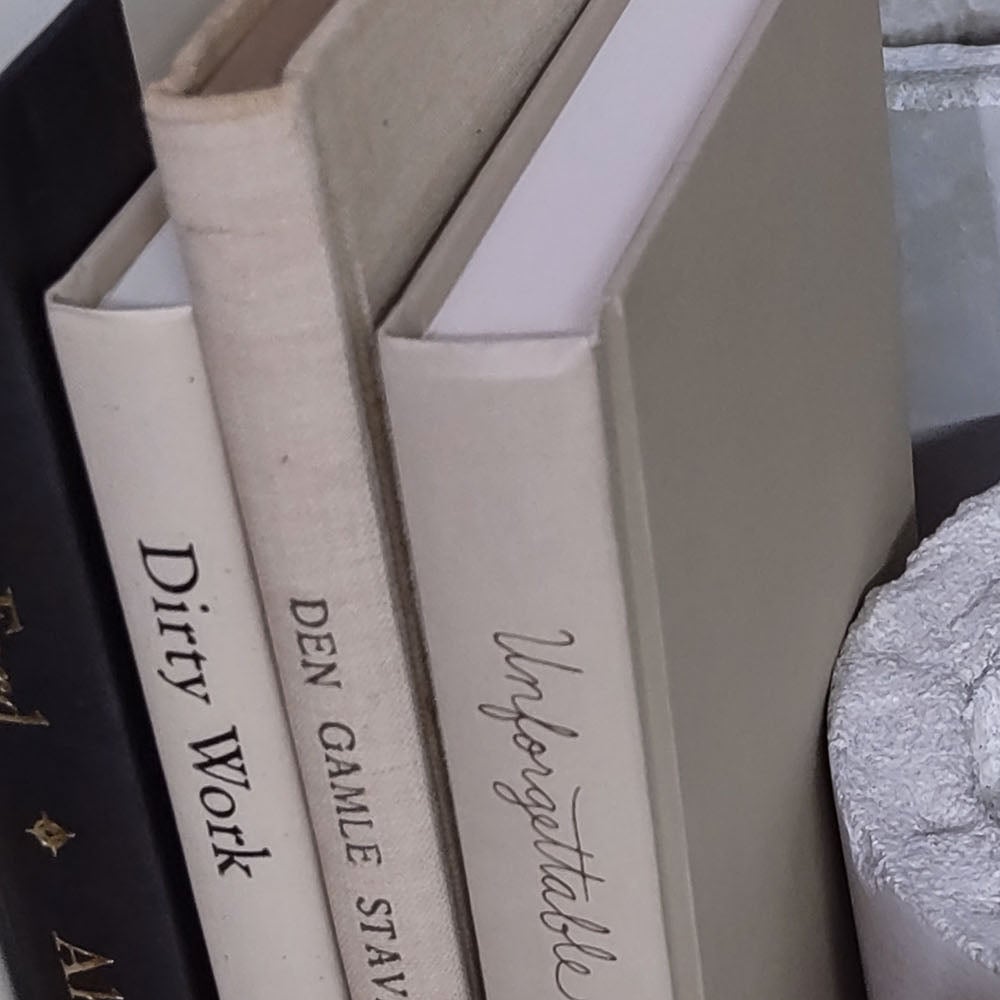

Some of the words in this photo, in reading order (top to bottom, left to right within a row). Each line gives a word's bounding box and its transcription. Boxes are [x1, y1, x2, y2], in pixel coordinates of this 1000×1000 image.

[138, 539, 210, 705] Dirty
[188, 725, 271, 878] Work
[289, 597, 342, 688] DEN
[317, 721, 382, 868] GAMLE
